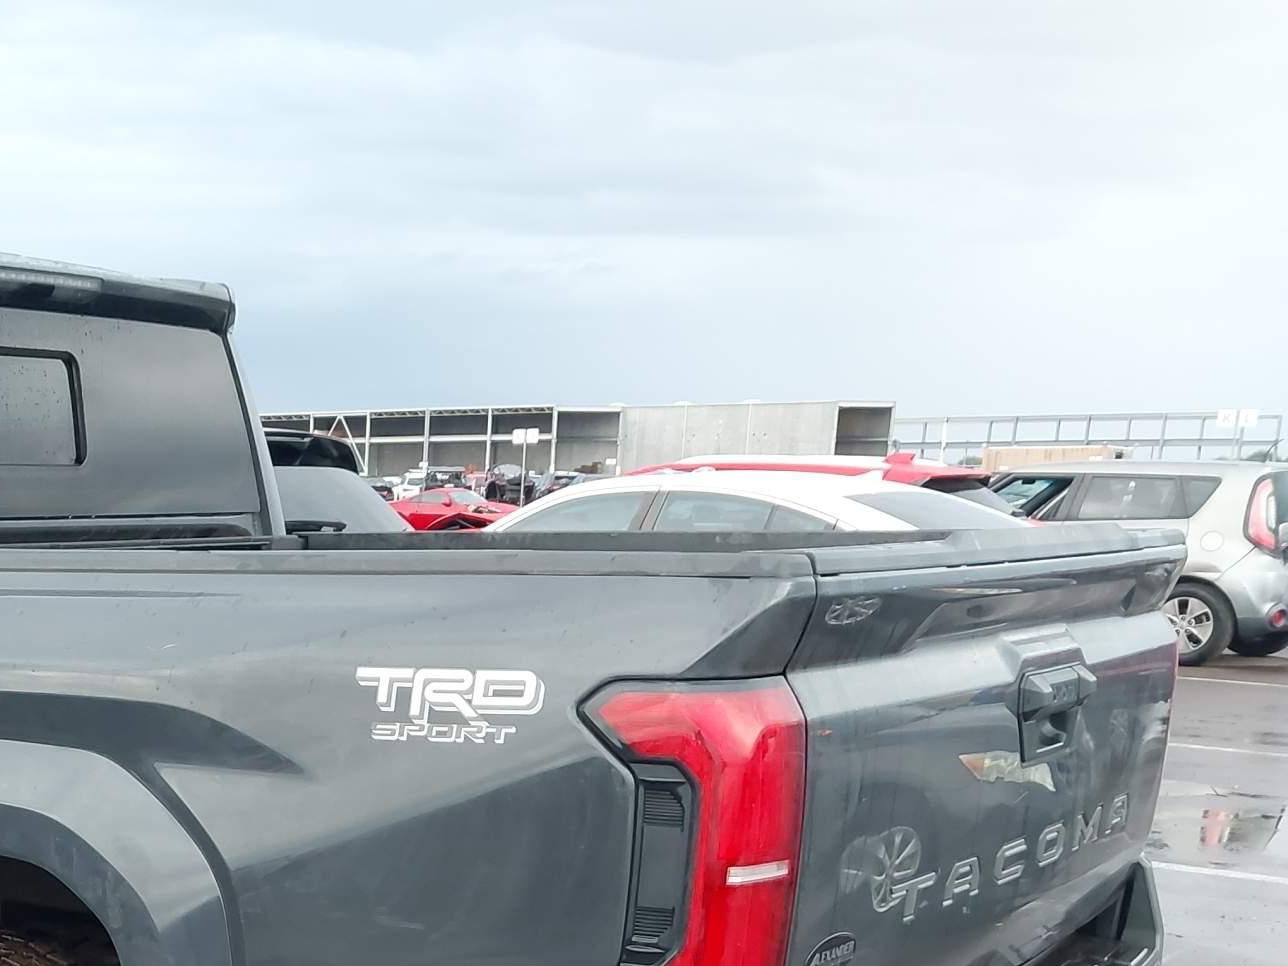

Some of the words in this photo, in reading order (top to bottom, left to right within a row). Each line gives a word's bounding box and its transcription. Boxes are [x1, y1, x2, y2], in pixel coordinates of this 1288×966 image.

[355, 666, 545, 726] TRD
[370, 721, 516, 744] SPORT
[890, 792, 1128, 923] TACOMA
